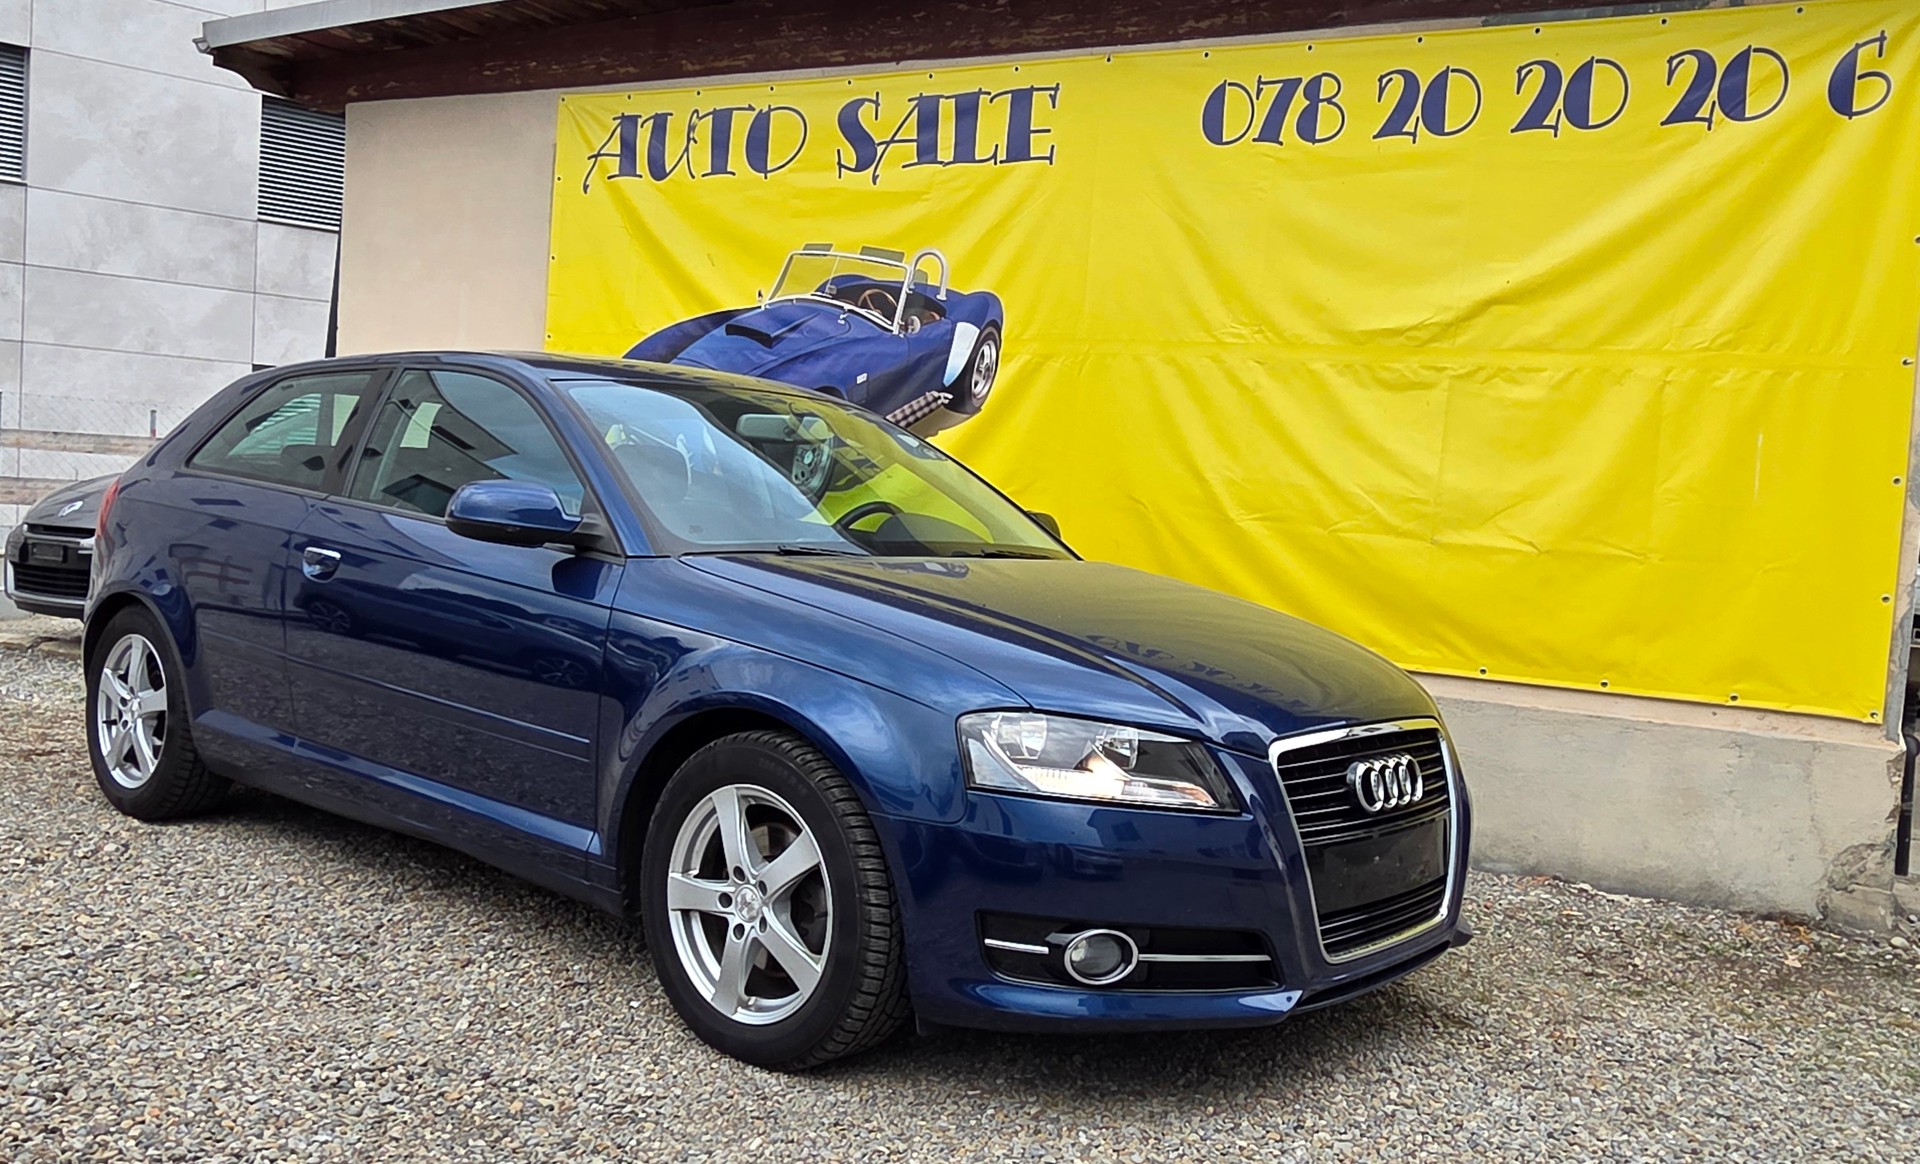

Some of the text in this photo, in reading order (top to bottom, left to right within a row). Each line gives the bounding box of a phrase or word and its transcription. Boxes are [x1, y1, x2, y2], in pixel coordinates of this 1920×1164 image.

[582, 83, 1061, 193] AUTO SALE
[1201, 31, 1893, 146] 078 20 20 20 6
